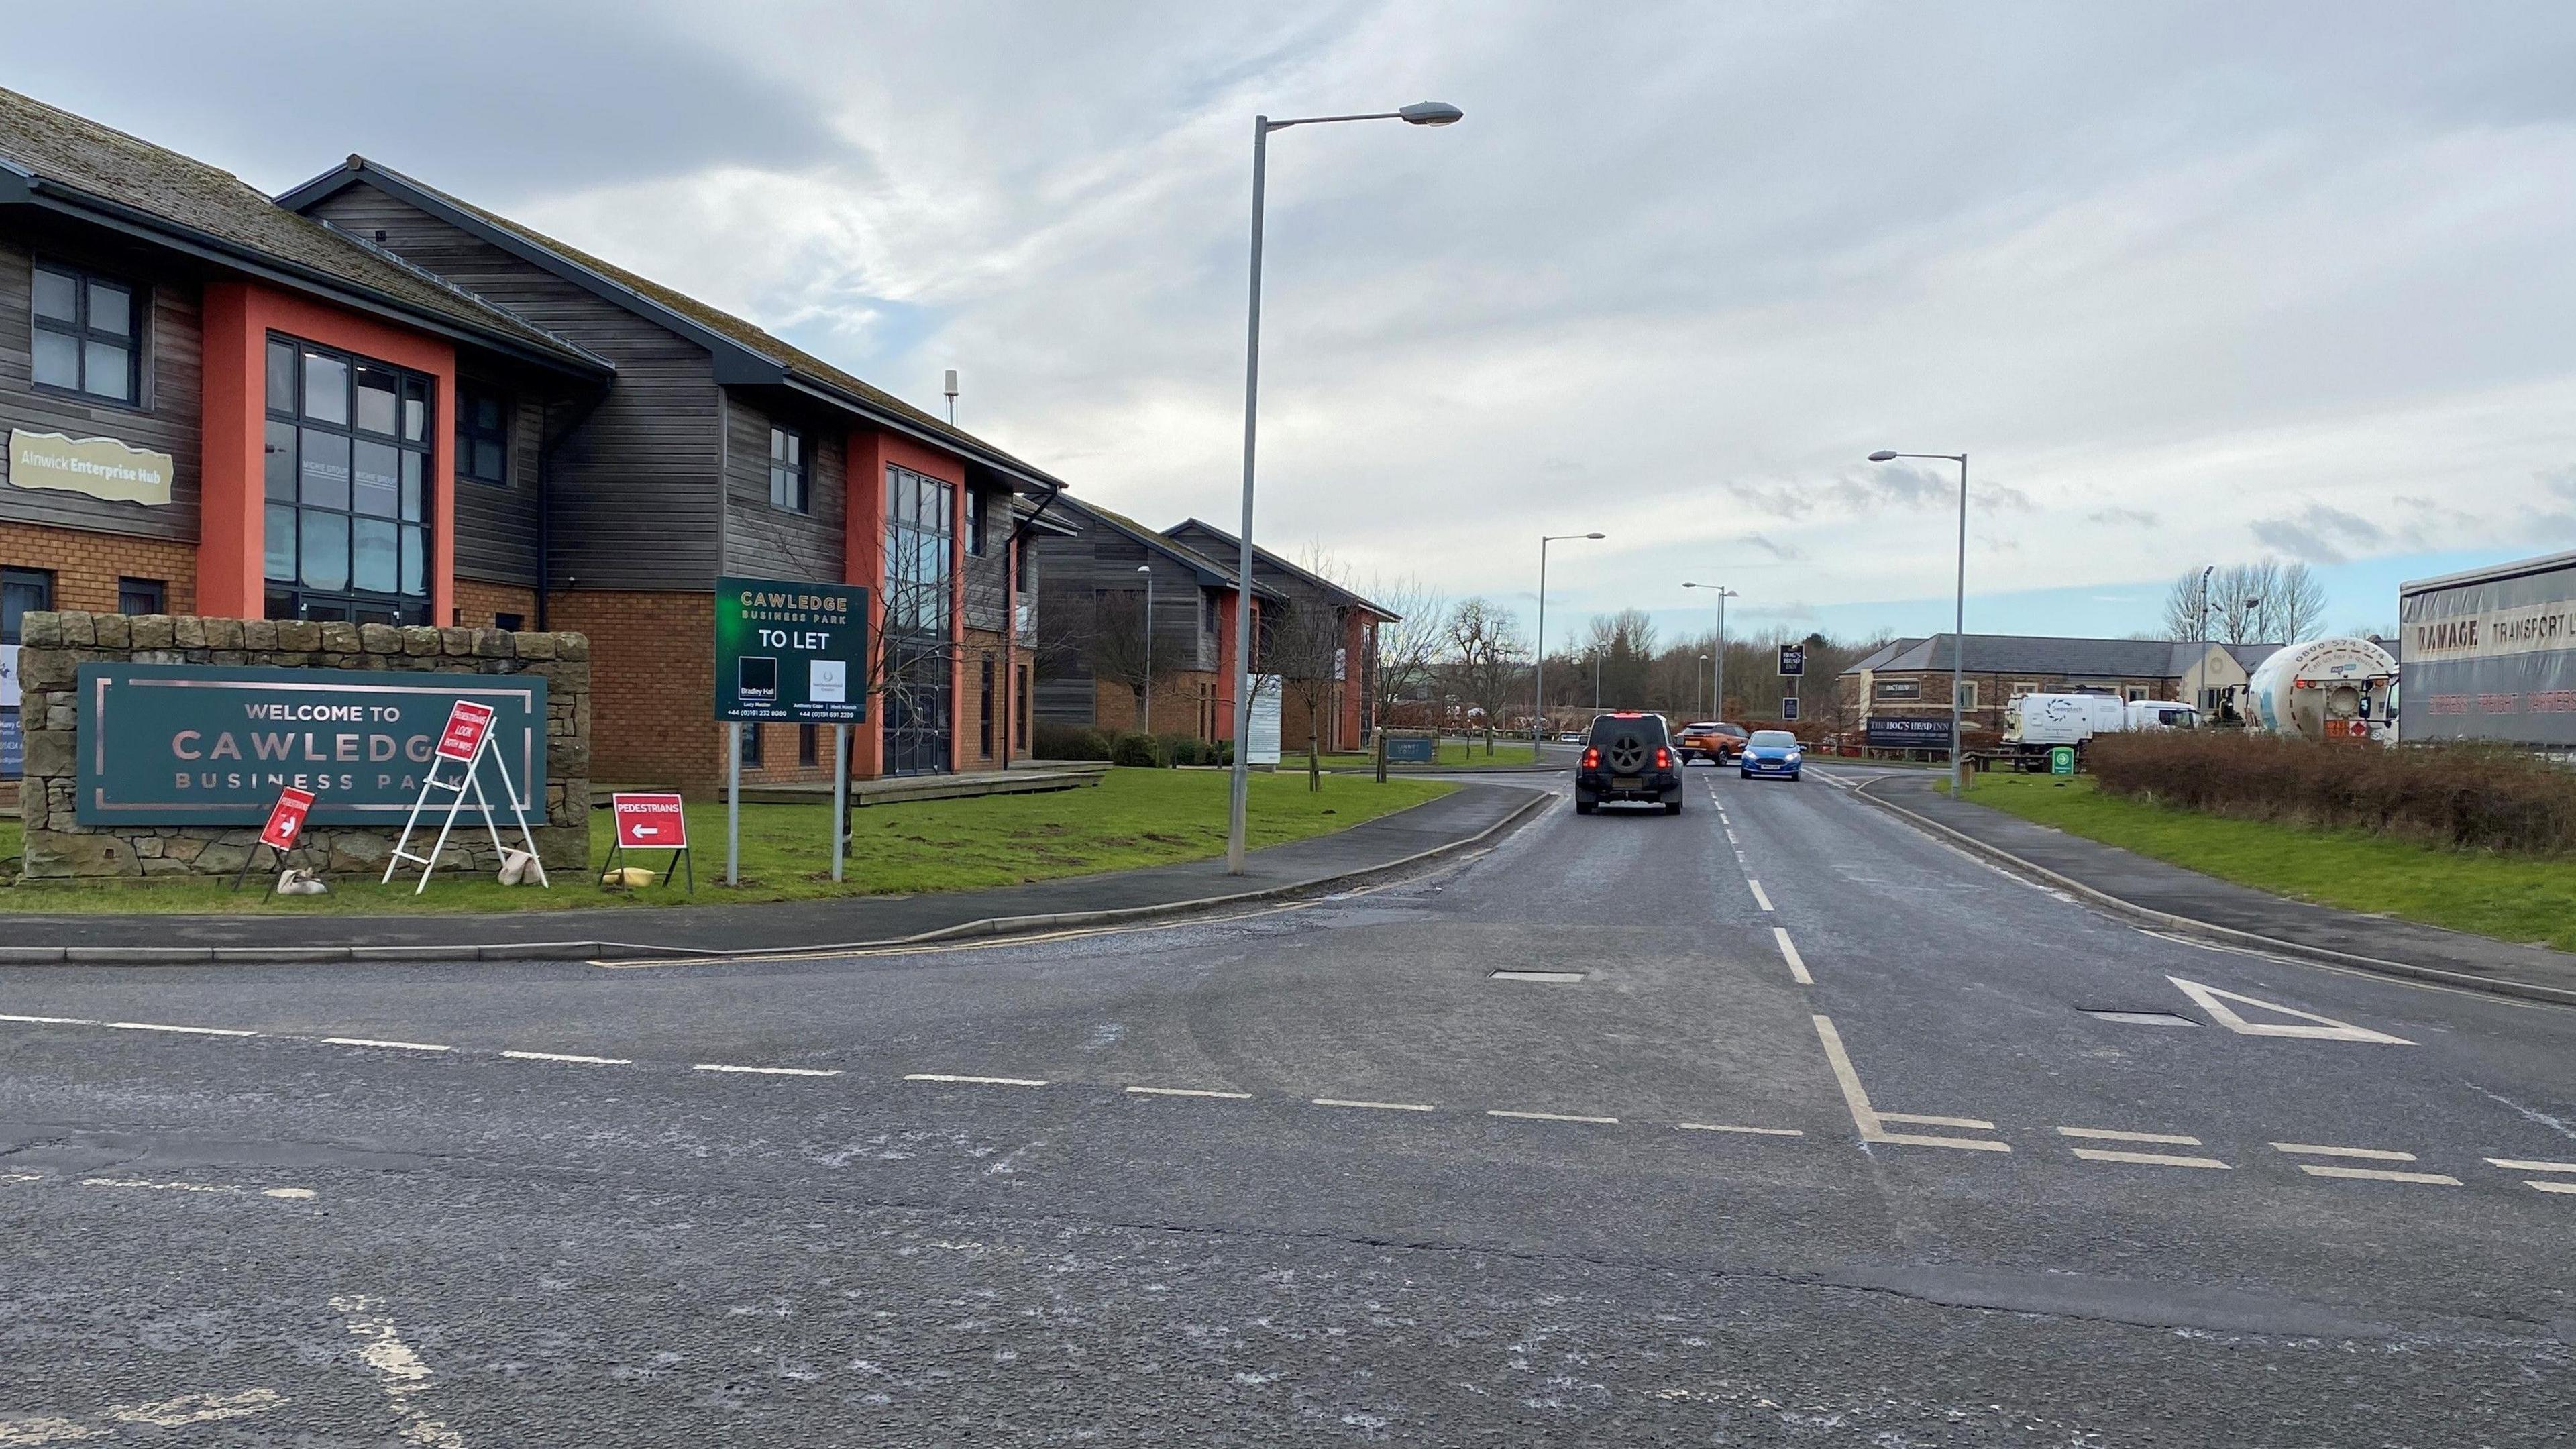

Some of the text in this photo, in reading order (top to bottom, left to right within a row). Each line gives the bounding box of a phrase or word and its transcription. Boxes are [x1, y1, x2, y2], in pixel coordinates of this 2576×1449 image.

[21, 450, 160, 484] Alnwick Enterprise Hub
[741, 591, 847, 612] CAWLEDGE
[742, 610, 846, 624] BUSINESS PARK
[759, 629, 830, 650] TO LET
[2418, 620, 2478, 651] RAMAGE
[2493, 614, 2565, 642] TRANSPORT
[2296, 643, 2325, 662] 0800
[2363, 644, 2385, 659] 574
[741, 688, 762, 696] Bradley
[244, 704, 400, 722] WELCOME TO
[455, 724, 474, 737] LOOK
[1871, 721, 1949, 731] THE HOG'S HEAD INN
[172, 730, 463, 762] CAWLEDG
[618, 804, 679, 812] PEDESTRIANS
